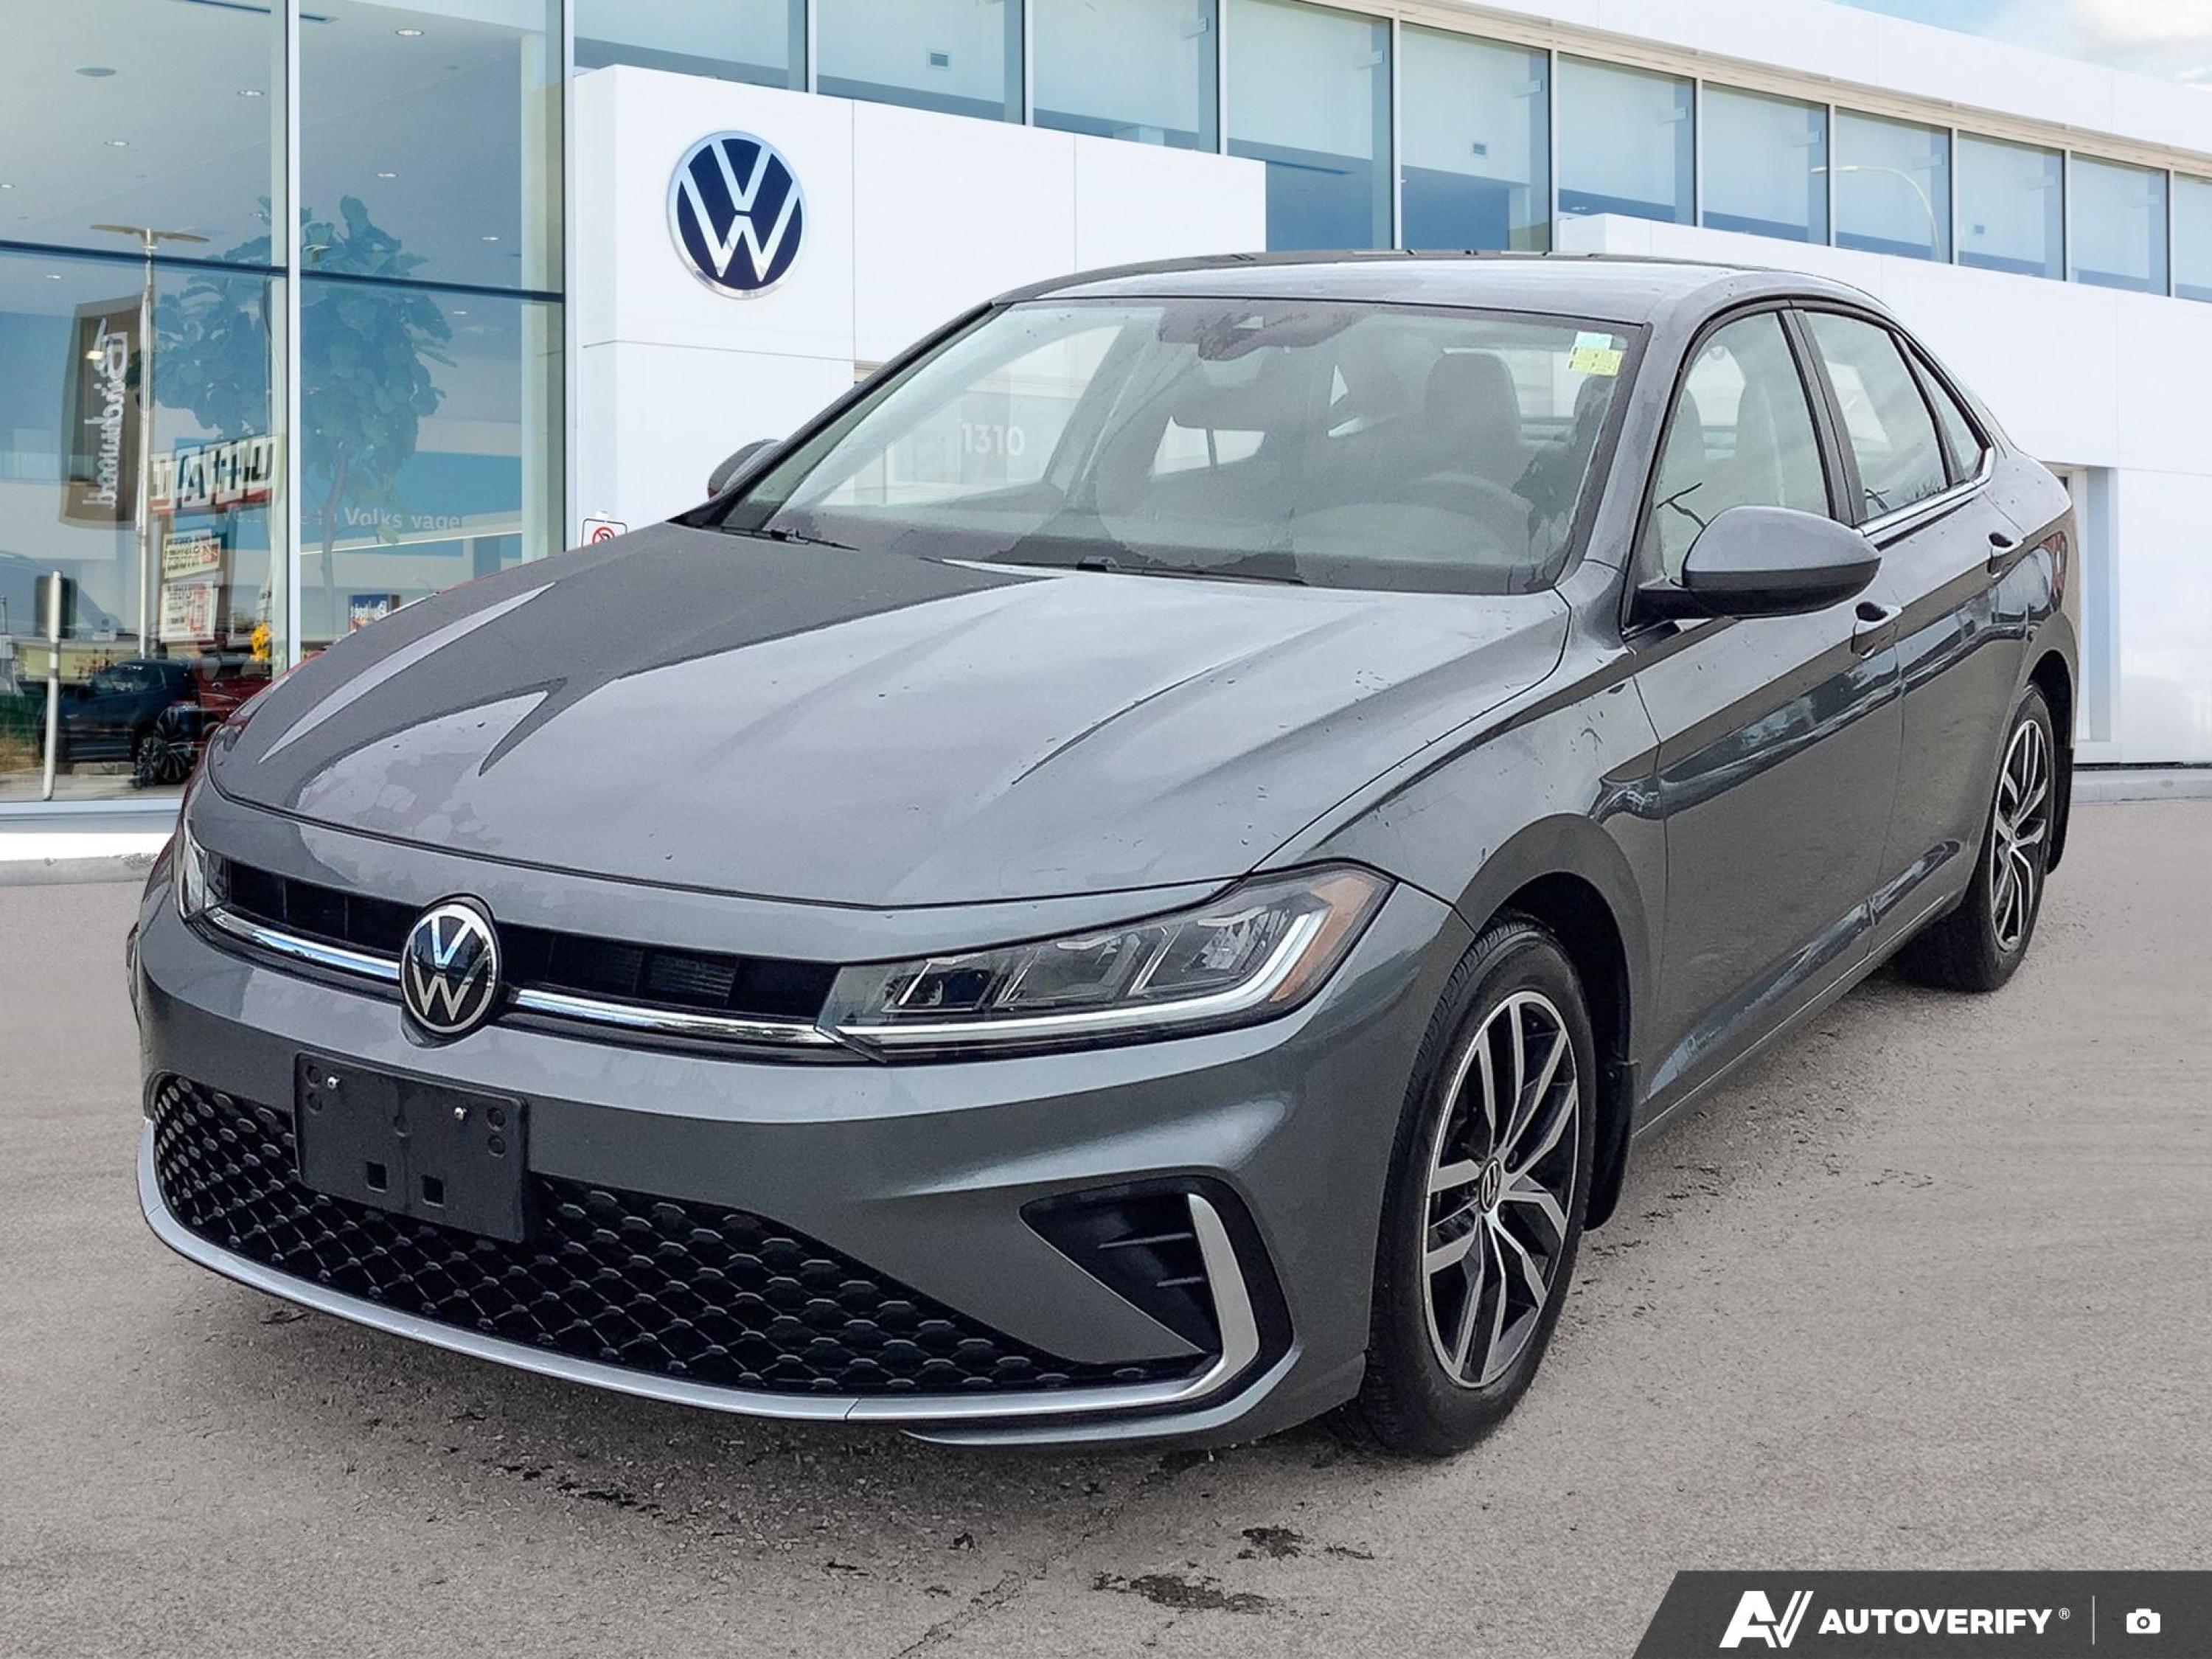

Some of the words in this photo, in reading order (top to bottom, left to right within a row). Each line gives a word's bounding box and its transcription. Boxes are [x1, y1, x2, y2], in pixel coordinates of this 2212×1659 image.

[674, 137, 802, 283] VW
[961, 423, 1026, 456] 1310
[407, 911, 493, 1025] VW
